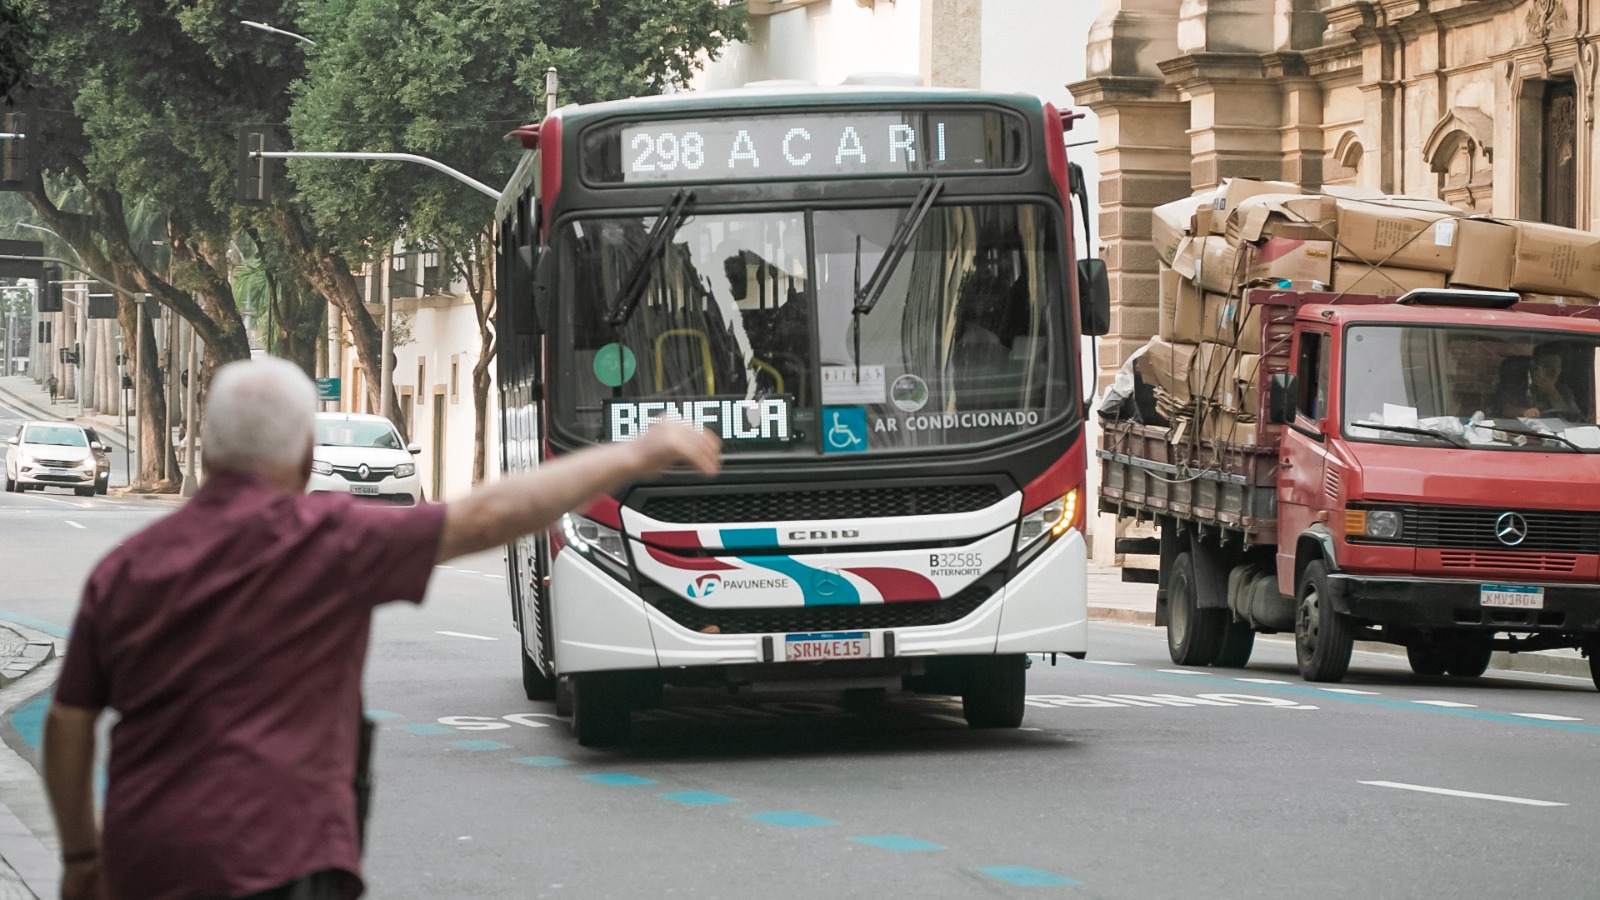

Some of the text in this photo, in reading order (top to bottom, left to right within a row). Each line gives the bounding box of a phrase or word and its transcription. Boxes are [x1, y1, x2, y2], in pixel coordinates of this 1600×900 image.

[631, 122, 946, 172] 298 ACARI
[874, 411, 1039, 432] AR CONDICIONADO
[788, 529, 860, 541] CAIO
[930, 553, 983, 567] B32585
[930, 568, 982, 576] INTERNORTE
[723, 578, 788, 590] PAVUNENSE
[793, 641, 861, 660] SRH4E15
